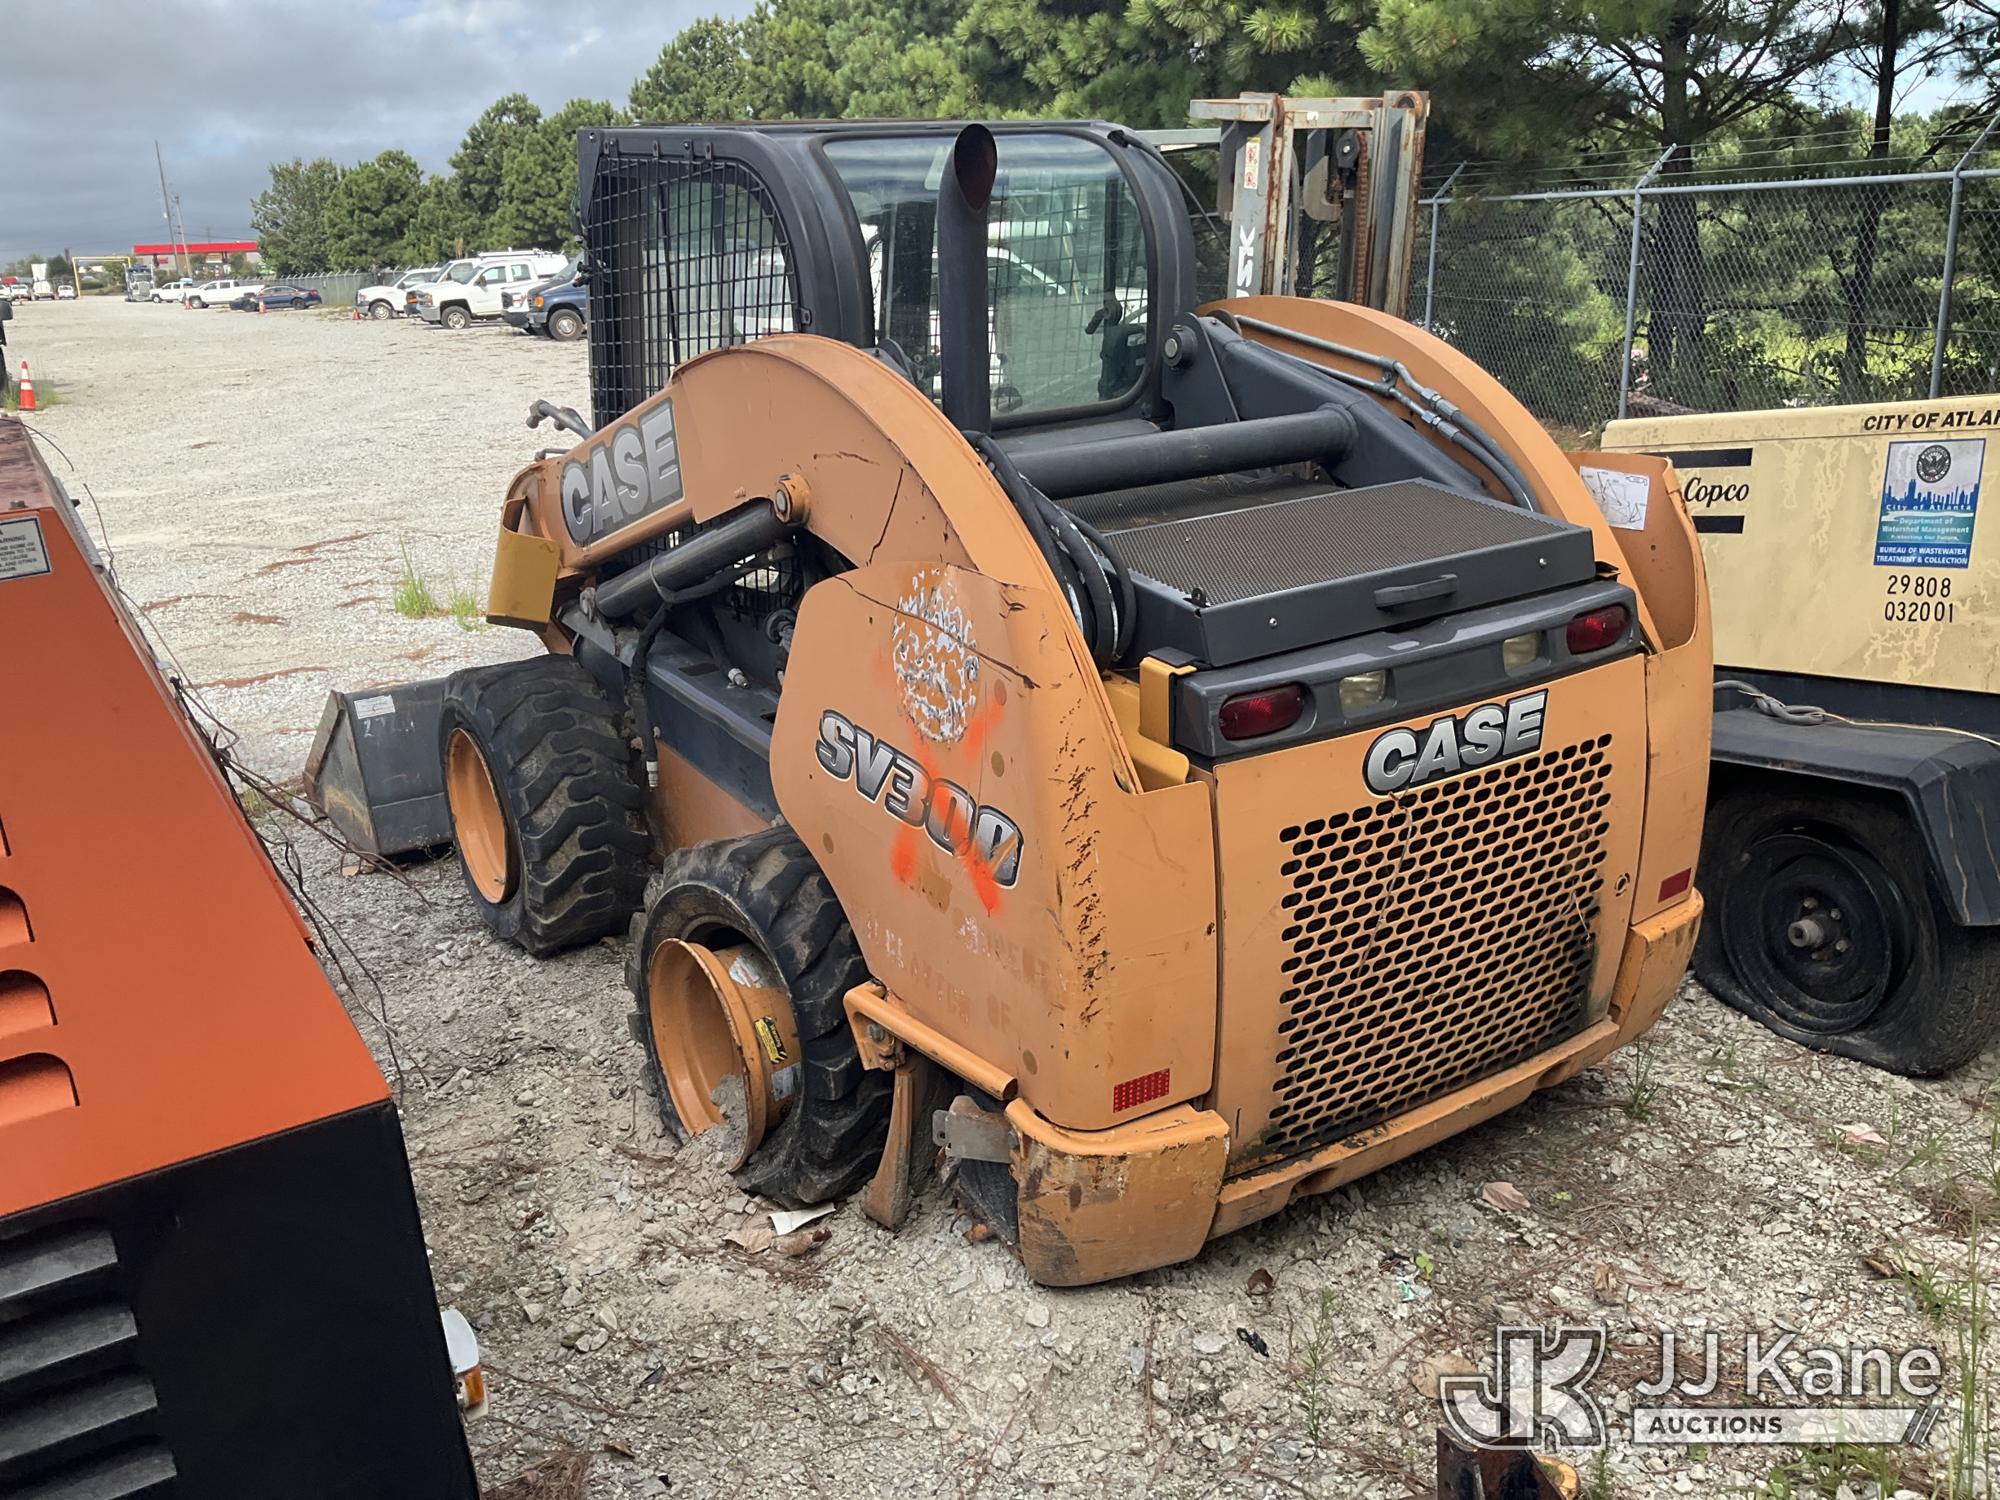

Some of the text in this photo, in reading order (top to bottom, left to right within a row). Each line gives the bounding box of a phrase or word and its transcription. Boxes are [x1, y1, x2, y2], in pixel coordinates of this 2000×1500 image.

[1863, 414, 1908, 431] CITY
[1911, 412, 1940, 428] OF
[561, 398, 682, 547] CASE
[1684, 476, 1749, 508] Copco
[1886, 504, 1908, 512] City
[1882, 525, 1969, 534] Watershed Management
[1944, 517, 1953, 525] of
[1876, 555, 1915, 563] TREATMENT
[1879, 546, 1907, 554] BUREAU
[1919, 547, 1967, 555] WASTEWATER
[1887, 574, 1951, 598] 29808
[1363, 688, 1548, 796] CASE
[815, 708, 1025, 890] SV300
